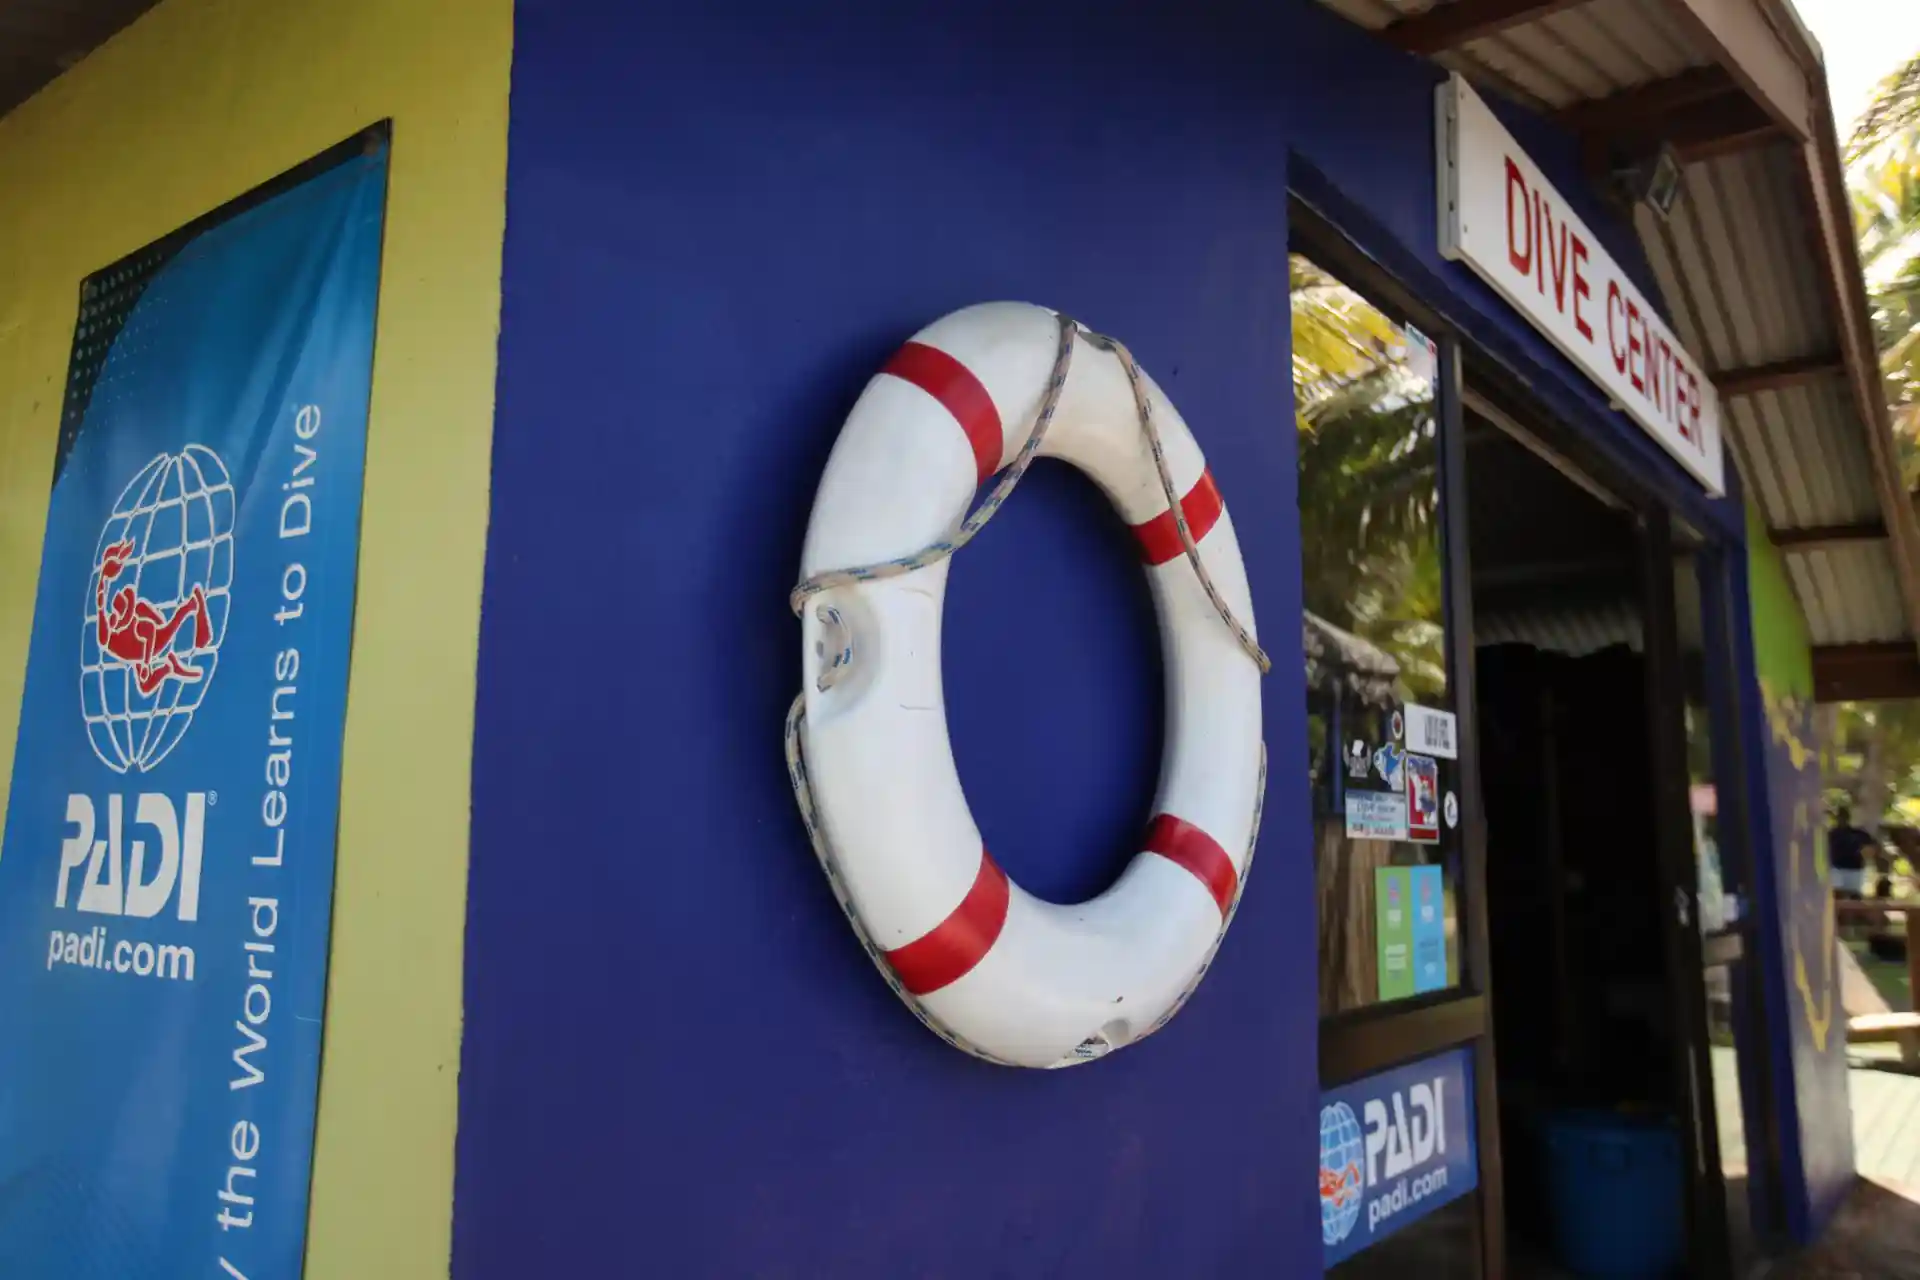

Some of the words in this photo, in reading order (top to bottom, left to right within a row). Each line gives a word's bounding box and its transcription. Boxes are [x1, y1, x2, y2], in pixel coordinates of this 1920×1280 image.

[1504, 154, 1594, 344] DIVE
[1606, 279, 1707, 456] CENTER
[279, 402, 322, 541] Dive
[274, 563, 307, 627] to
[251, 656, 301, 869] Learns
[54, 791, 206, 922] PADI
[46, 925, 196, 982] padi.com
[230, 896, 279, 1092] World
[216, 1119, 260, 1232] the
[1363, 1076, 1446, 1188] PADI
[1368, 1166, 1448, 1234] padi.com
